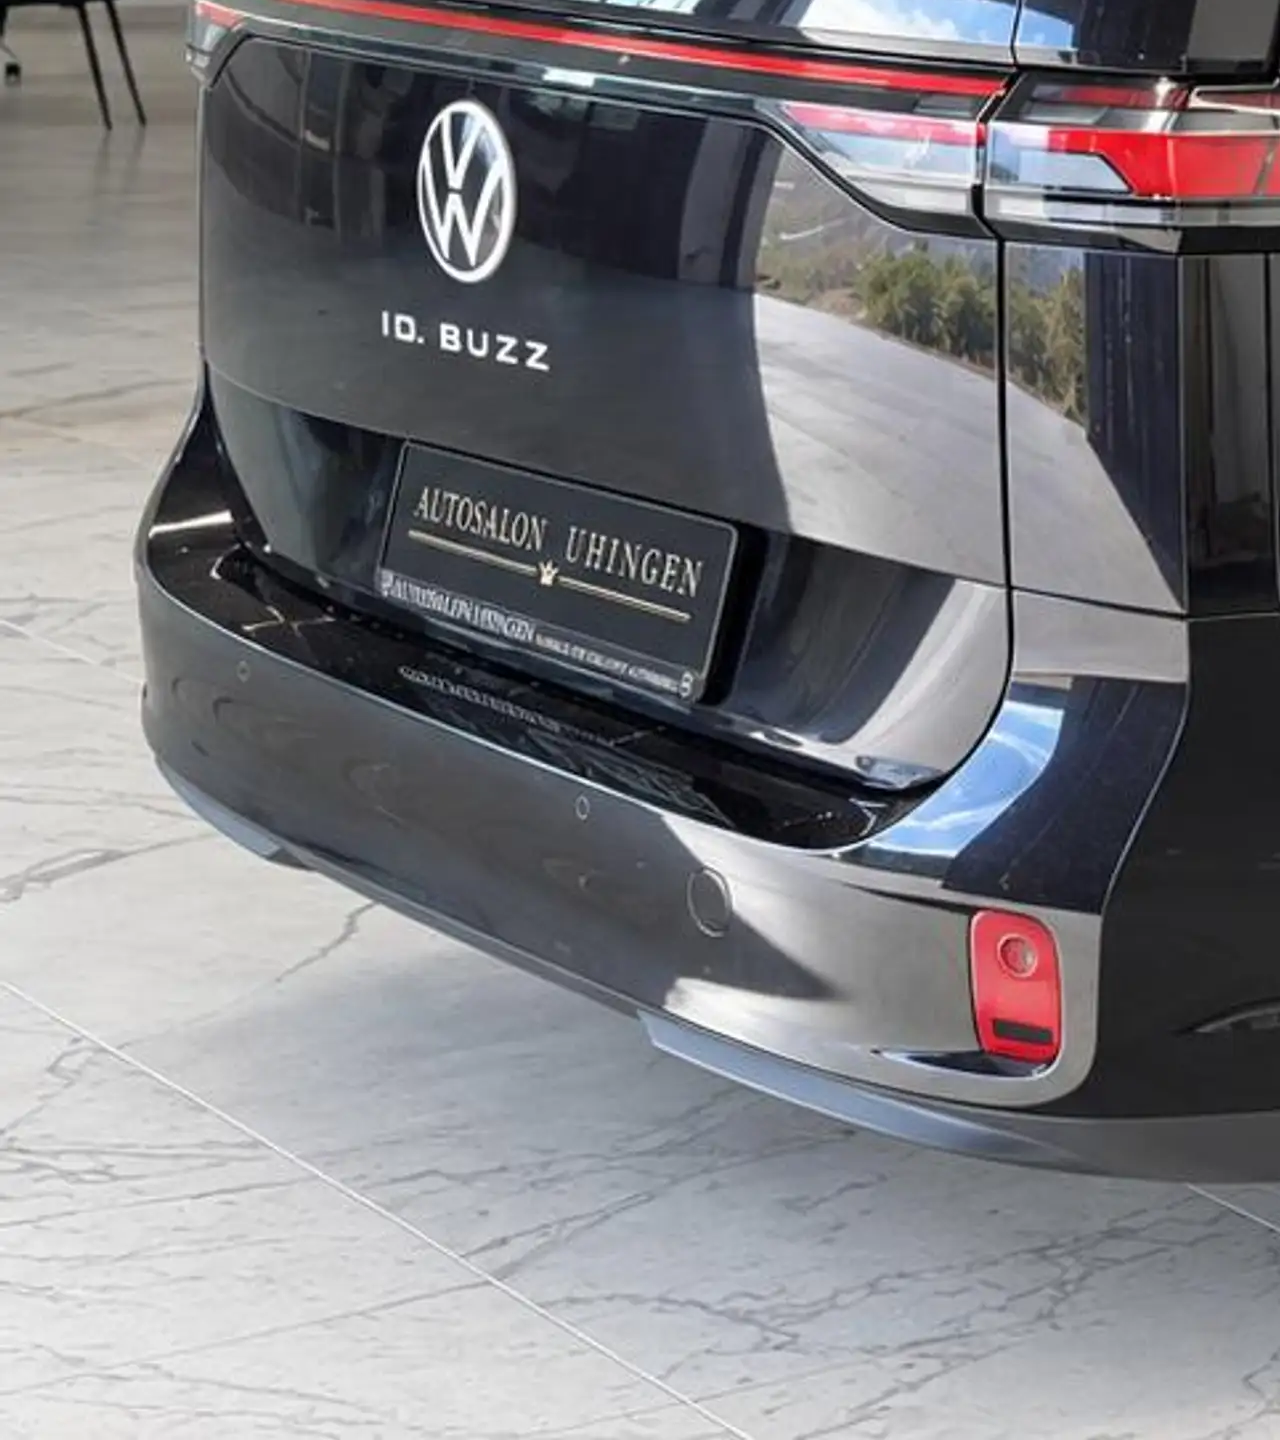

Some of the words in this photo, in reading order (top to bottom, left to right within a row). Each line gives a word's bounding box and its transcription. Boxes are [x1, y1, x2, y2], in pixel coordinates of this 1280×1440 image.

[381, 310, 425, 344] ID.
[439, 322, 550, 372] BUZZ
[413, 486, 549, 552] AUTOSALON
[566, 525, 703, 599] UHINGEN
